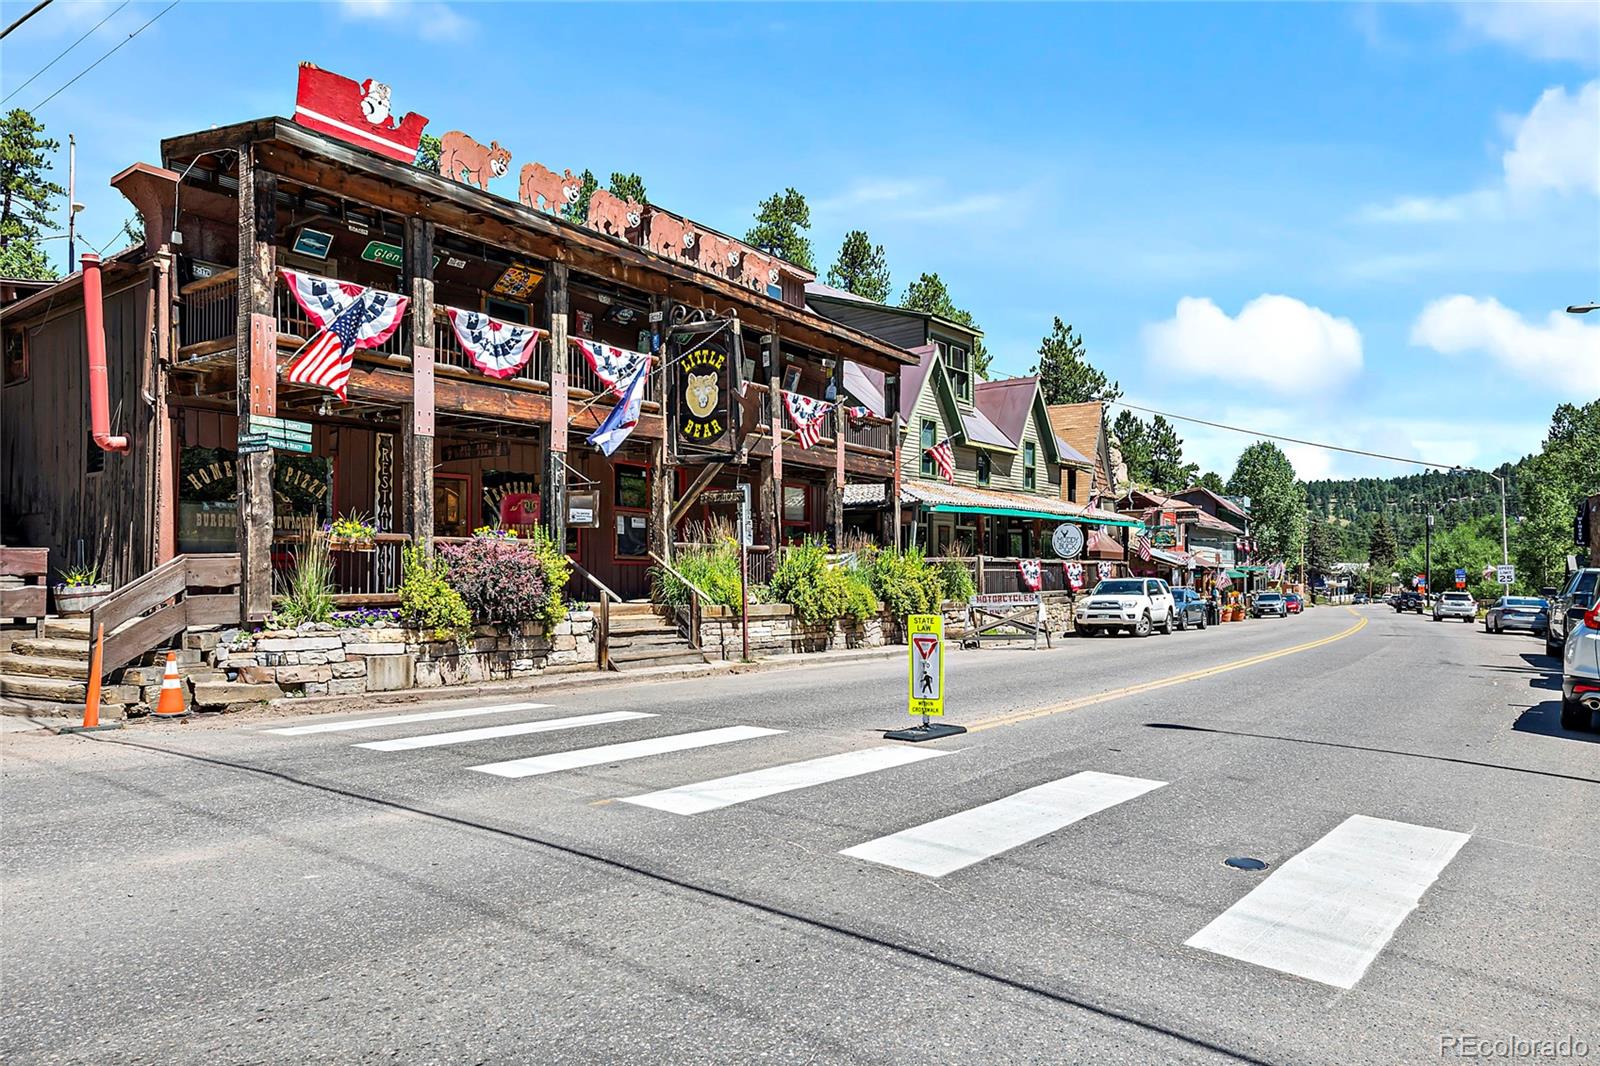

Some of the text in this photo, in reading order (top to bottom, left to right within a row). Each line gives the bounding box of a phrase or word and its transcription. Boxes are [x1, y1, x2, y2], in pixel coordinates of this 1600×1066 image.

[681, 349, 725, 373] LITTLE
[684, 419, 722, 438] BEAR
[285, 466, 328, 499] PIZZA
[1057, 536, 1080, 544] MUDDY
[1499, 575, 1514, 583] 25
[976, 594, 1035, 603] MOTORCYCLES
[913, 617, 935, 625] STATE
[916, 624, 932, 632] LAW
